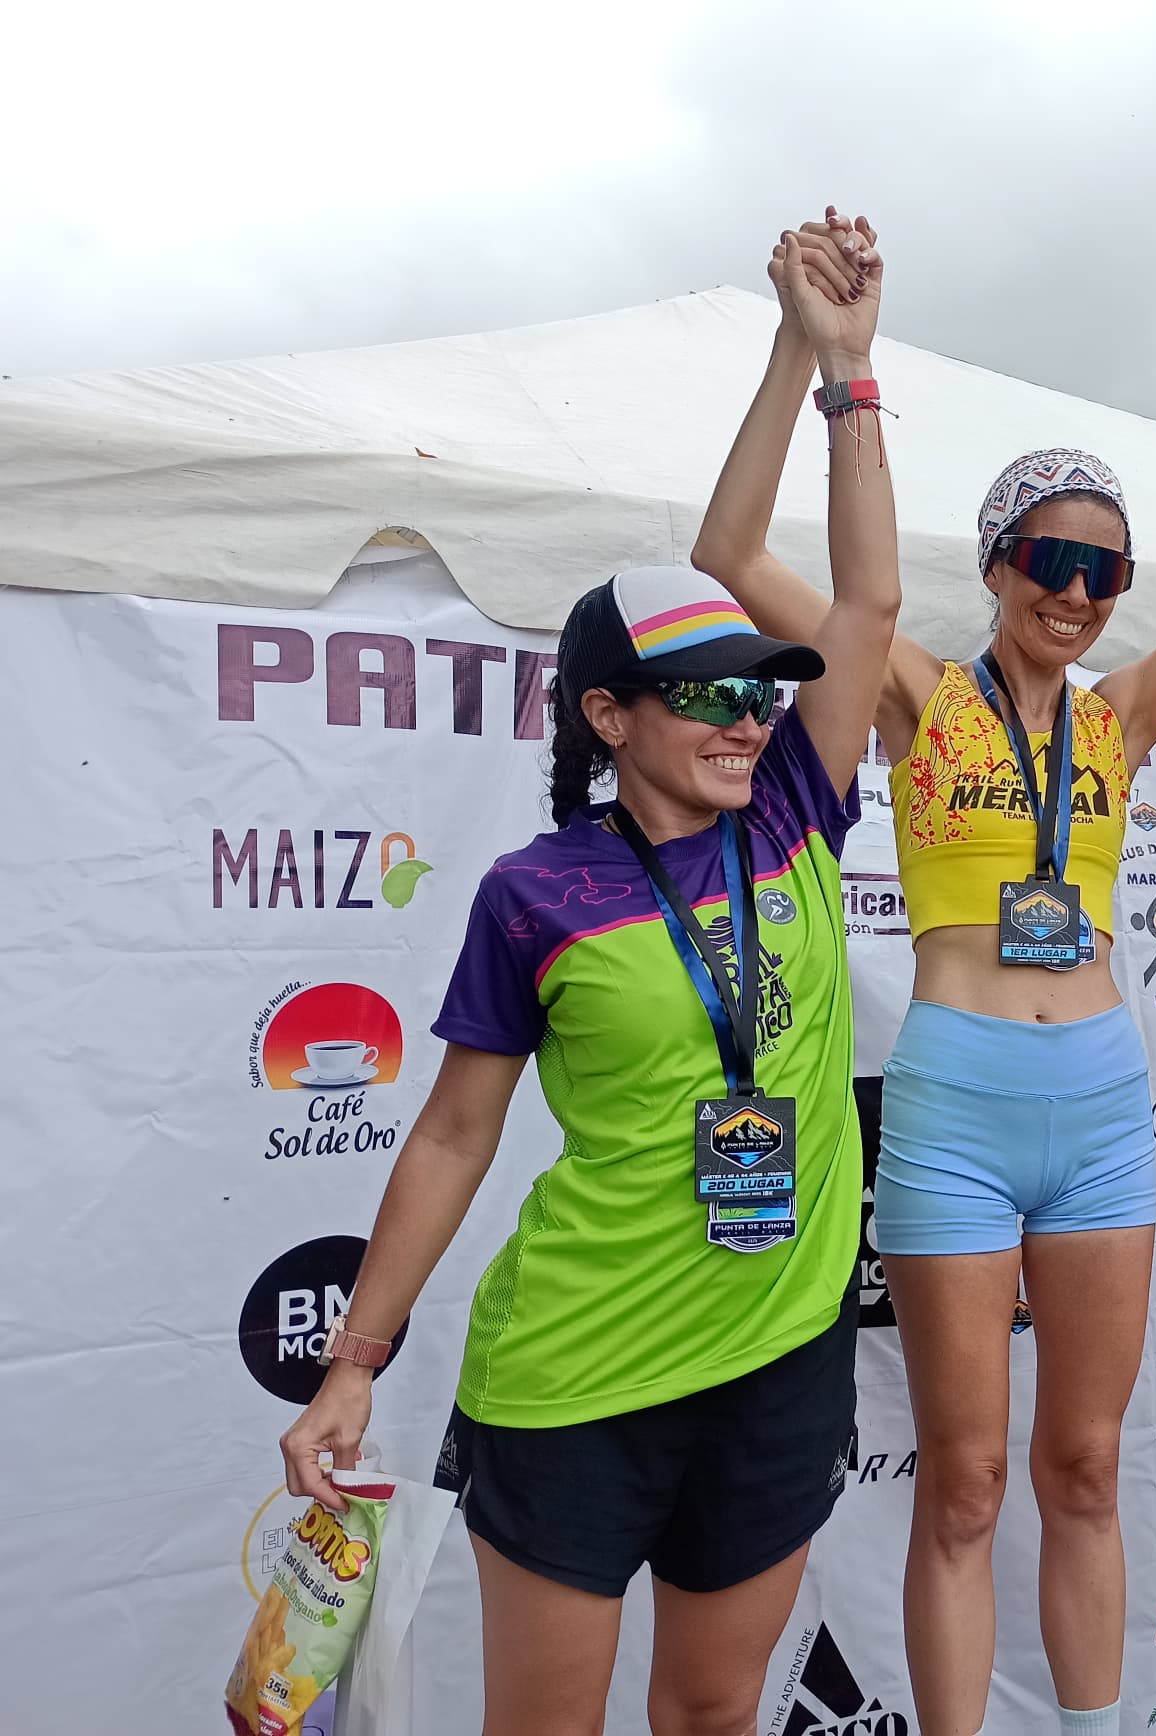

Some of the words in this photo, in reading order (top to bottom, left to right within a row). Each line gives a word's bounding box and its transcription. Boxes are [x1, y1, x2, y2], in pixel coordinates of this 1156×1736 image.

[955, 774, 995, 784] TRAIL
[950, 786, 1092, 815] MERA
[1003, 812, 1026, 820] TEAM
[1070, 816, 1093, 824] OCHA
[1119, 845, 1145, 863] LUB
[1032, 949, 1068, 957] LUGAR
[254, 1007, 272, 1031] deja
[249, 1032, 260, 1053] que
[248, 1056, 264, 1089] Sabor
[307, 1090, 366, 1124] Café
[264, 1127, 313, 1160] Sol
[315, 1126, 349, 1155] de
[707, 1181, 736, 1191] 2DO
[740, 1178, 785, 1189] LUGAR
[715, 1224, 745, 1232] PUNTA
[762, 1222, 791, 1230] LANZA
[772, 1705, 787, 1728] THE
[781, 1627, 815, 1702] ADVENTURE
[265, 1677, 289, 1700] 35g
